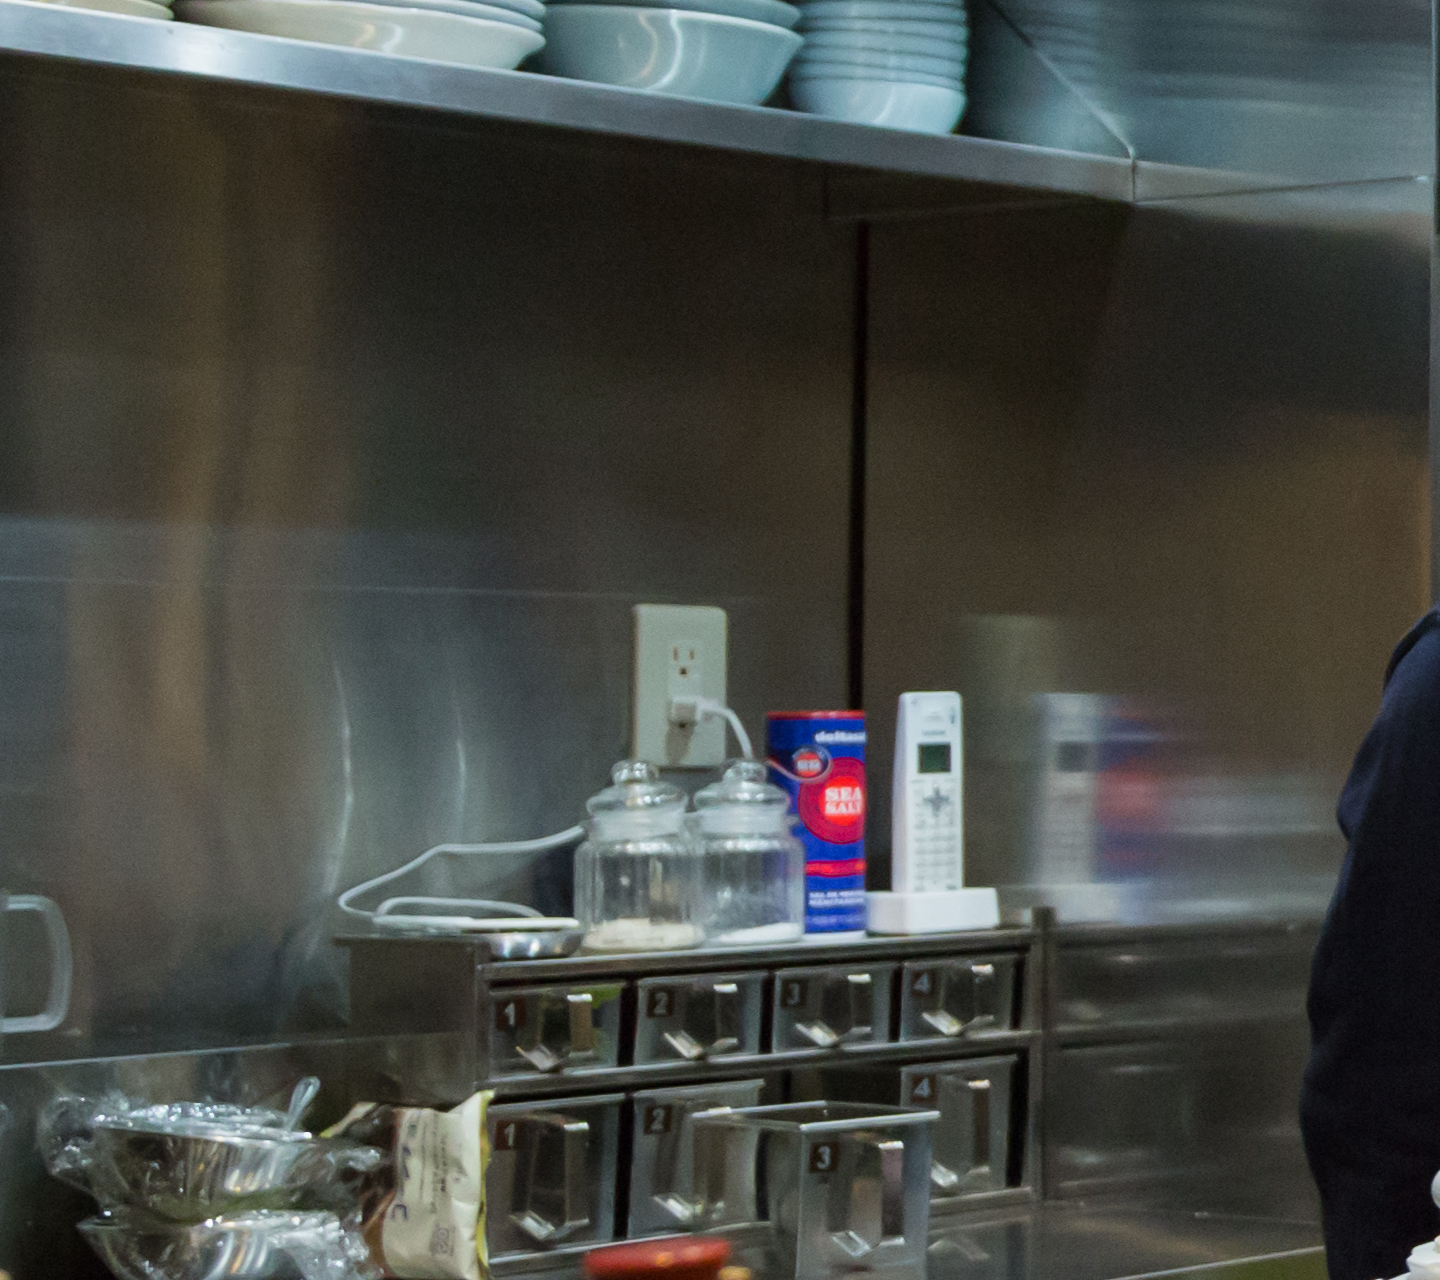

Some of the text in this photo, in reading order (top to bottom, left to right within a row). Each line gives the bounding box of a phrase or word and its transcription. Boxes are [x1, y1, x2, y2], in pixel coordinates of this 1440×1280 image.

[787, 981, 799, 1004] 3
[914, 971, 929, 993] 4
[504, 1001, 513, 1023] 1
[654, 991, 667, 1013] 2
[914, 1076, 929, 1097] 4
[652, 1106, 664, 1128] 2
[503, 1121, 514, 1143] 1
[817, 1144, 831, 1168] 3
